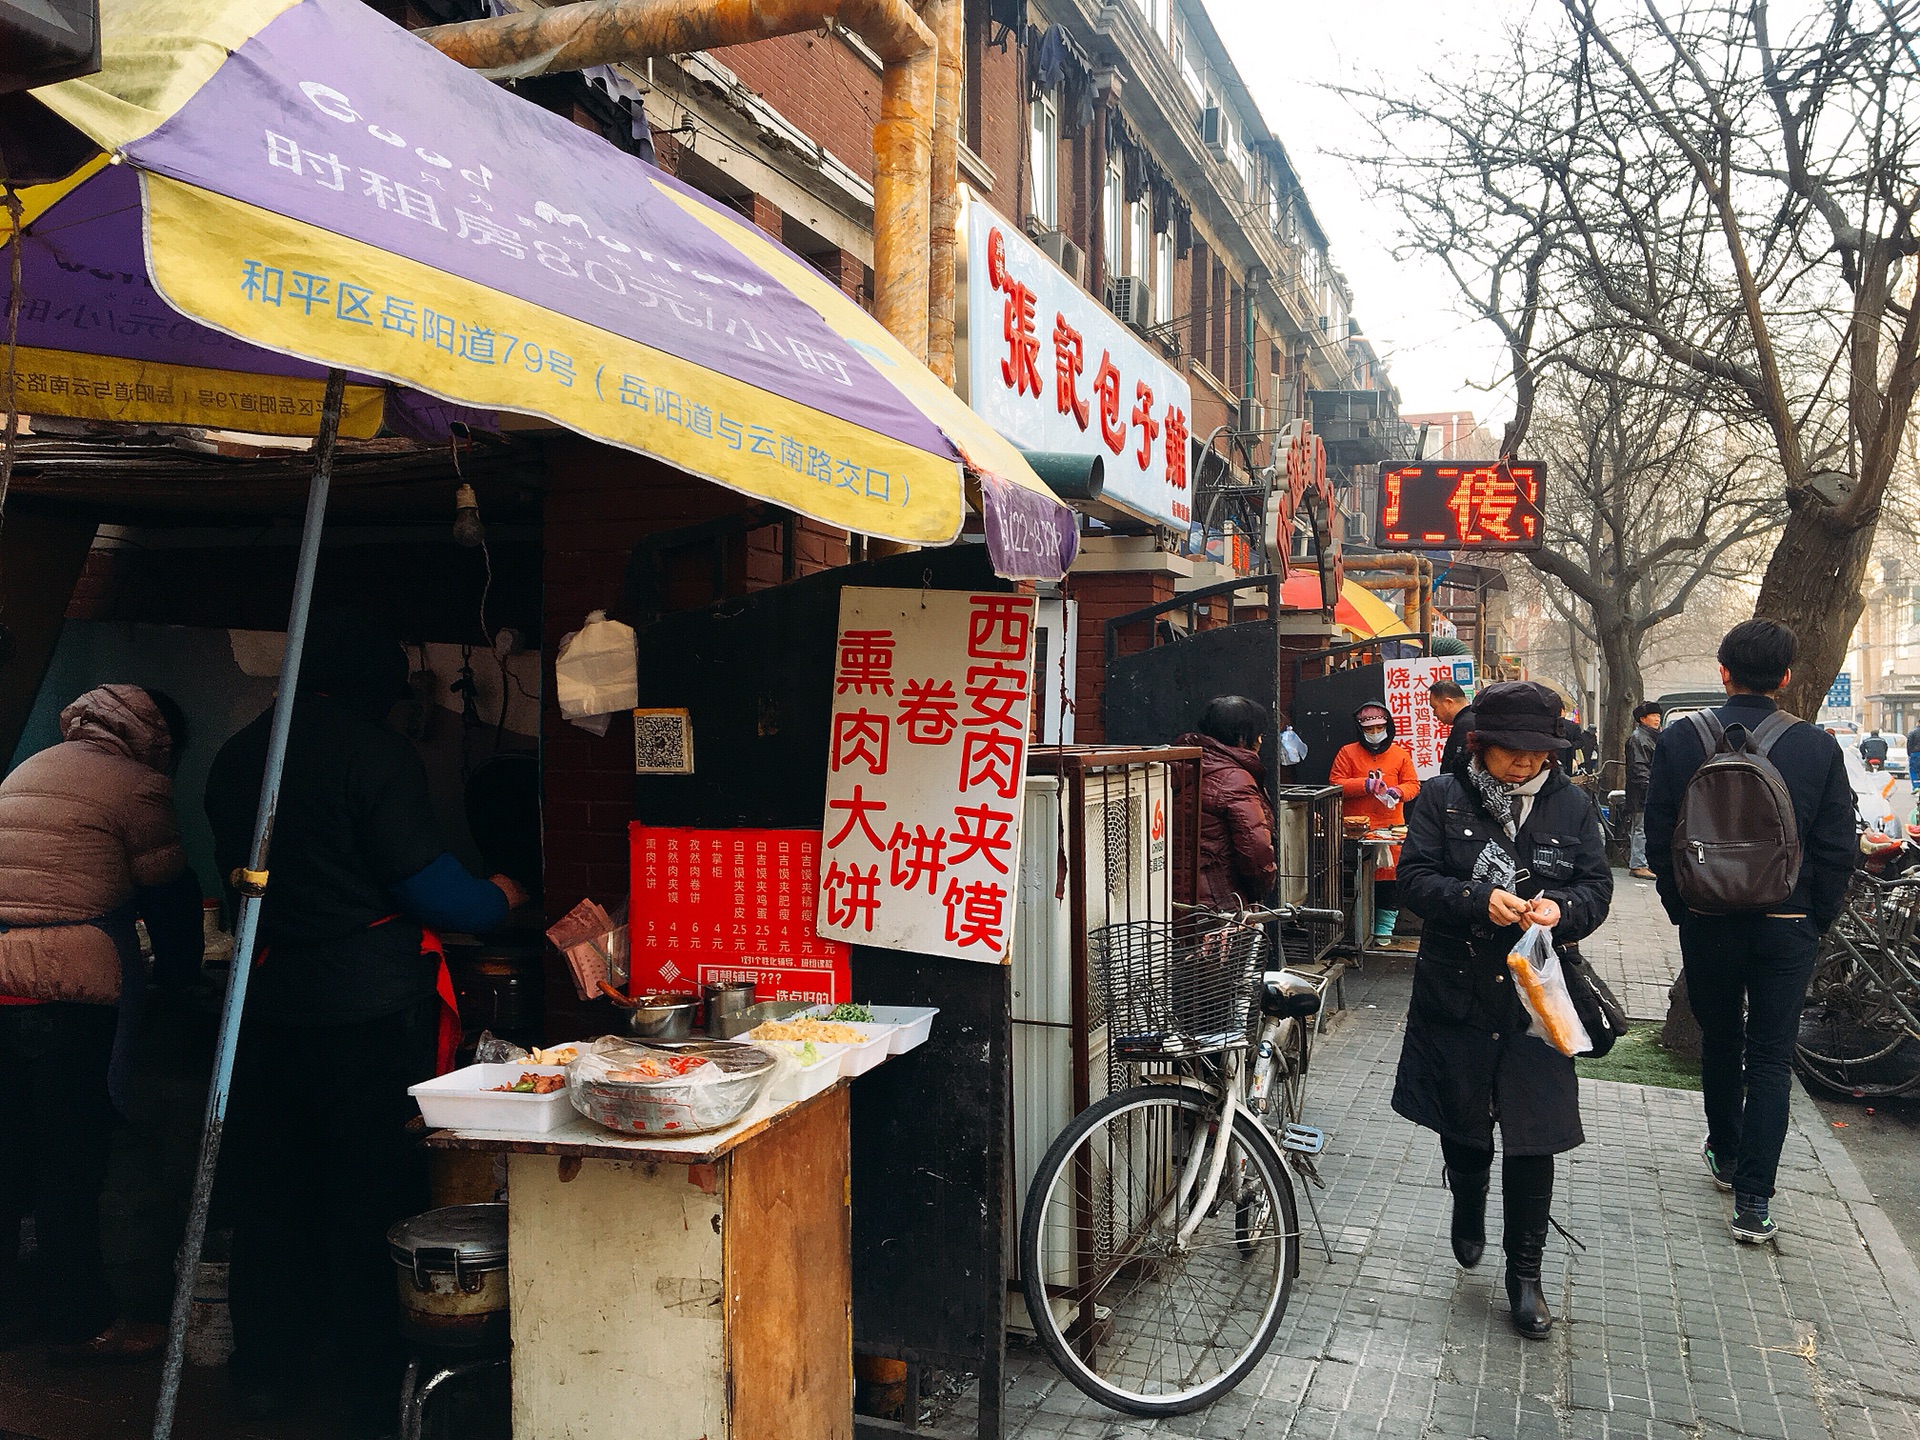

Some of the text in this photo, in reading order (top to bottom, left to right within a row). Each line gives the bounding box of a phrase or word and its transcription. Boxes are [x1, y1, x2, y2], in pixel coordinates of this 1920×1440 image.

[1001, 271, 1188, 491] 張記包子鋪
[1447, 473, 1520, 541] 传
[1412, 674, 1434, 769] 大饼鸡蛋夹菜
[1429, 665, 1454, 764] 鸡灌
[823, 629, 897, 933] 熏肉大饼
[886, 677, 959, 896] 卷饼
[942, 594, 1034, 953] 西安肉夹馍
[646, 838, 657, 890] 熏肉大饼
[667, 838, 679, 904] 孜然肉夹馍
[689, 838, 701, 904] 孜然肉卷饼
[733, 840, 745, 919] 白吉馍夹豆皮
[755, 840, 767, 920] 白吉馍夹鸡蛋
[778, 840, 790, 921] 白吉馍夹肥瘦
[801, 841, 813, 922] 白吉馍夹精瘦
